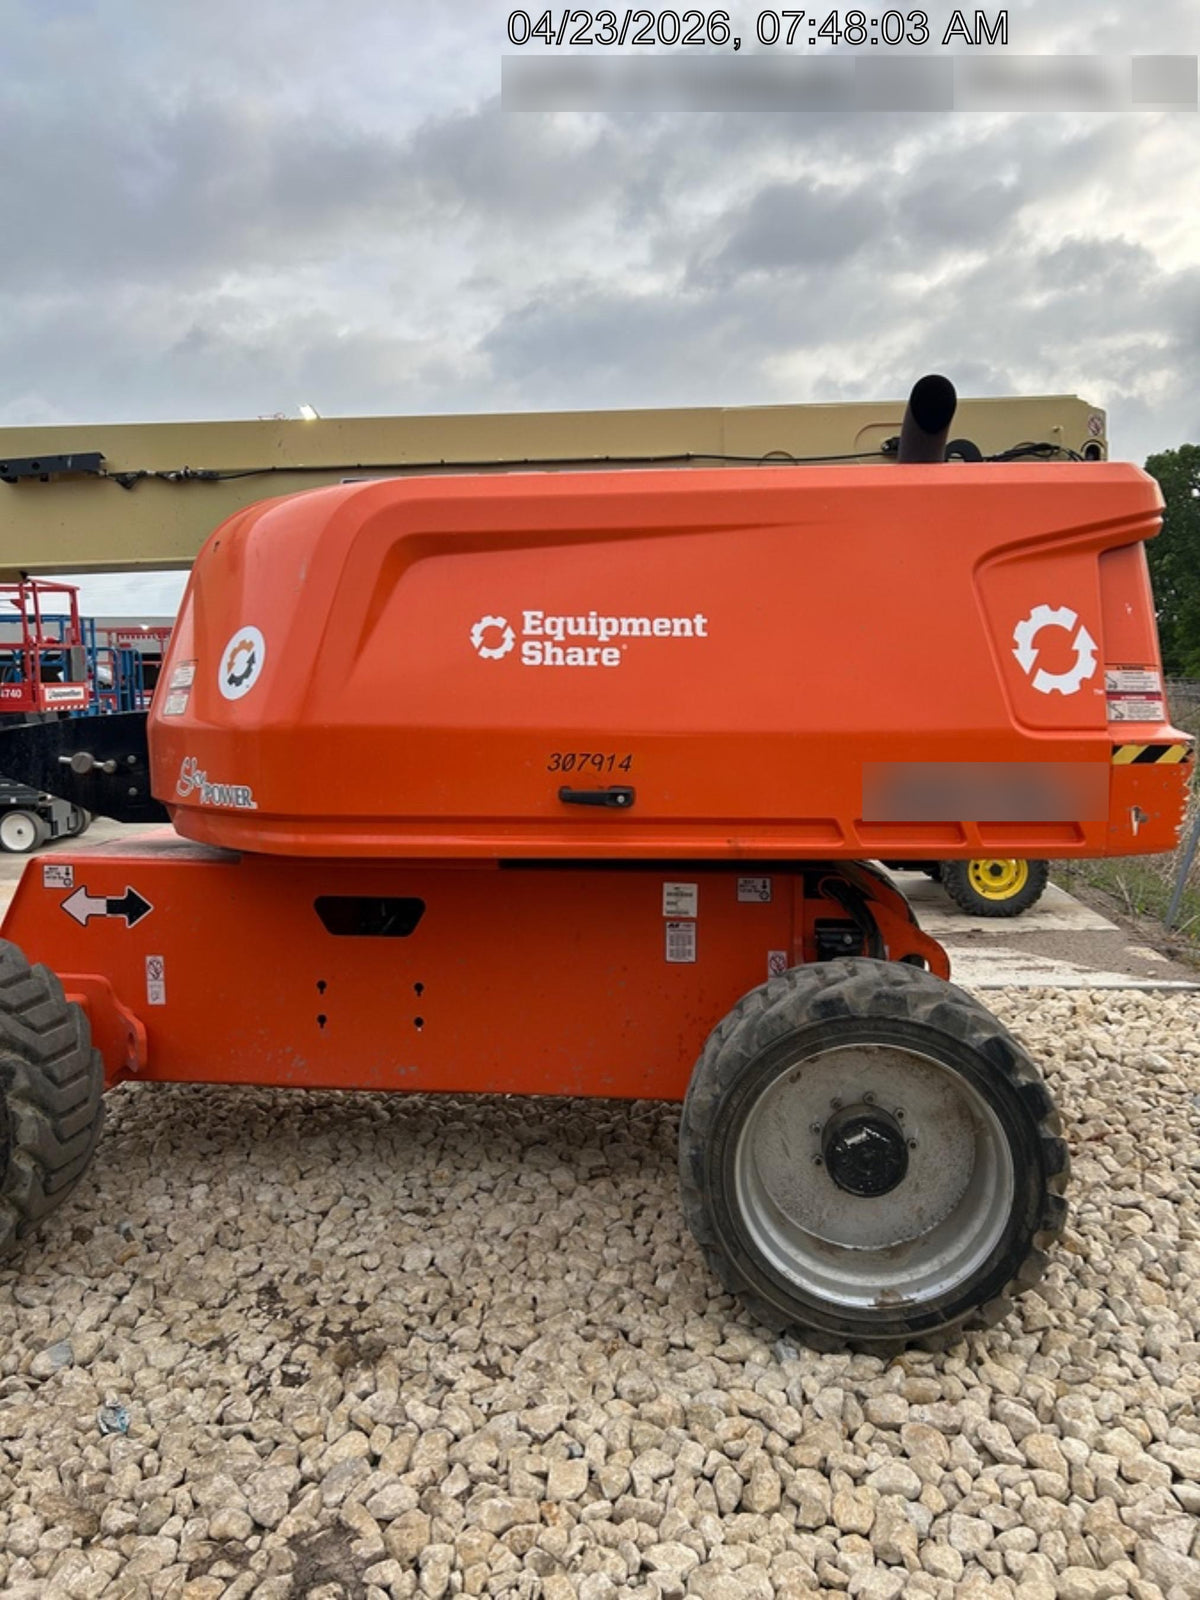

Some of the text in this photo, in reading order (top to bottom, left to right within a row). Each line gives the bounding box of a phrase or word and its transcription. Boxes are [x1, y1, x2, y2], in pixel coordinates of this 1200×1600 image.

[521, 610, 708, 641] Equipment
[521, 640, 621, 666] Share
[547, 753, 633, 772] 307914
